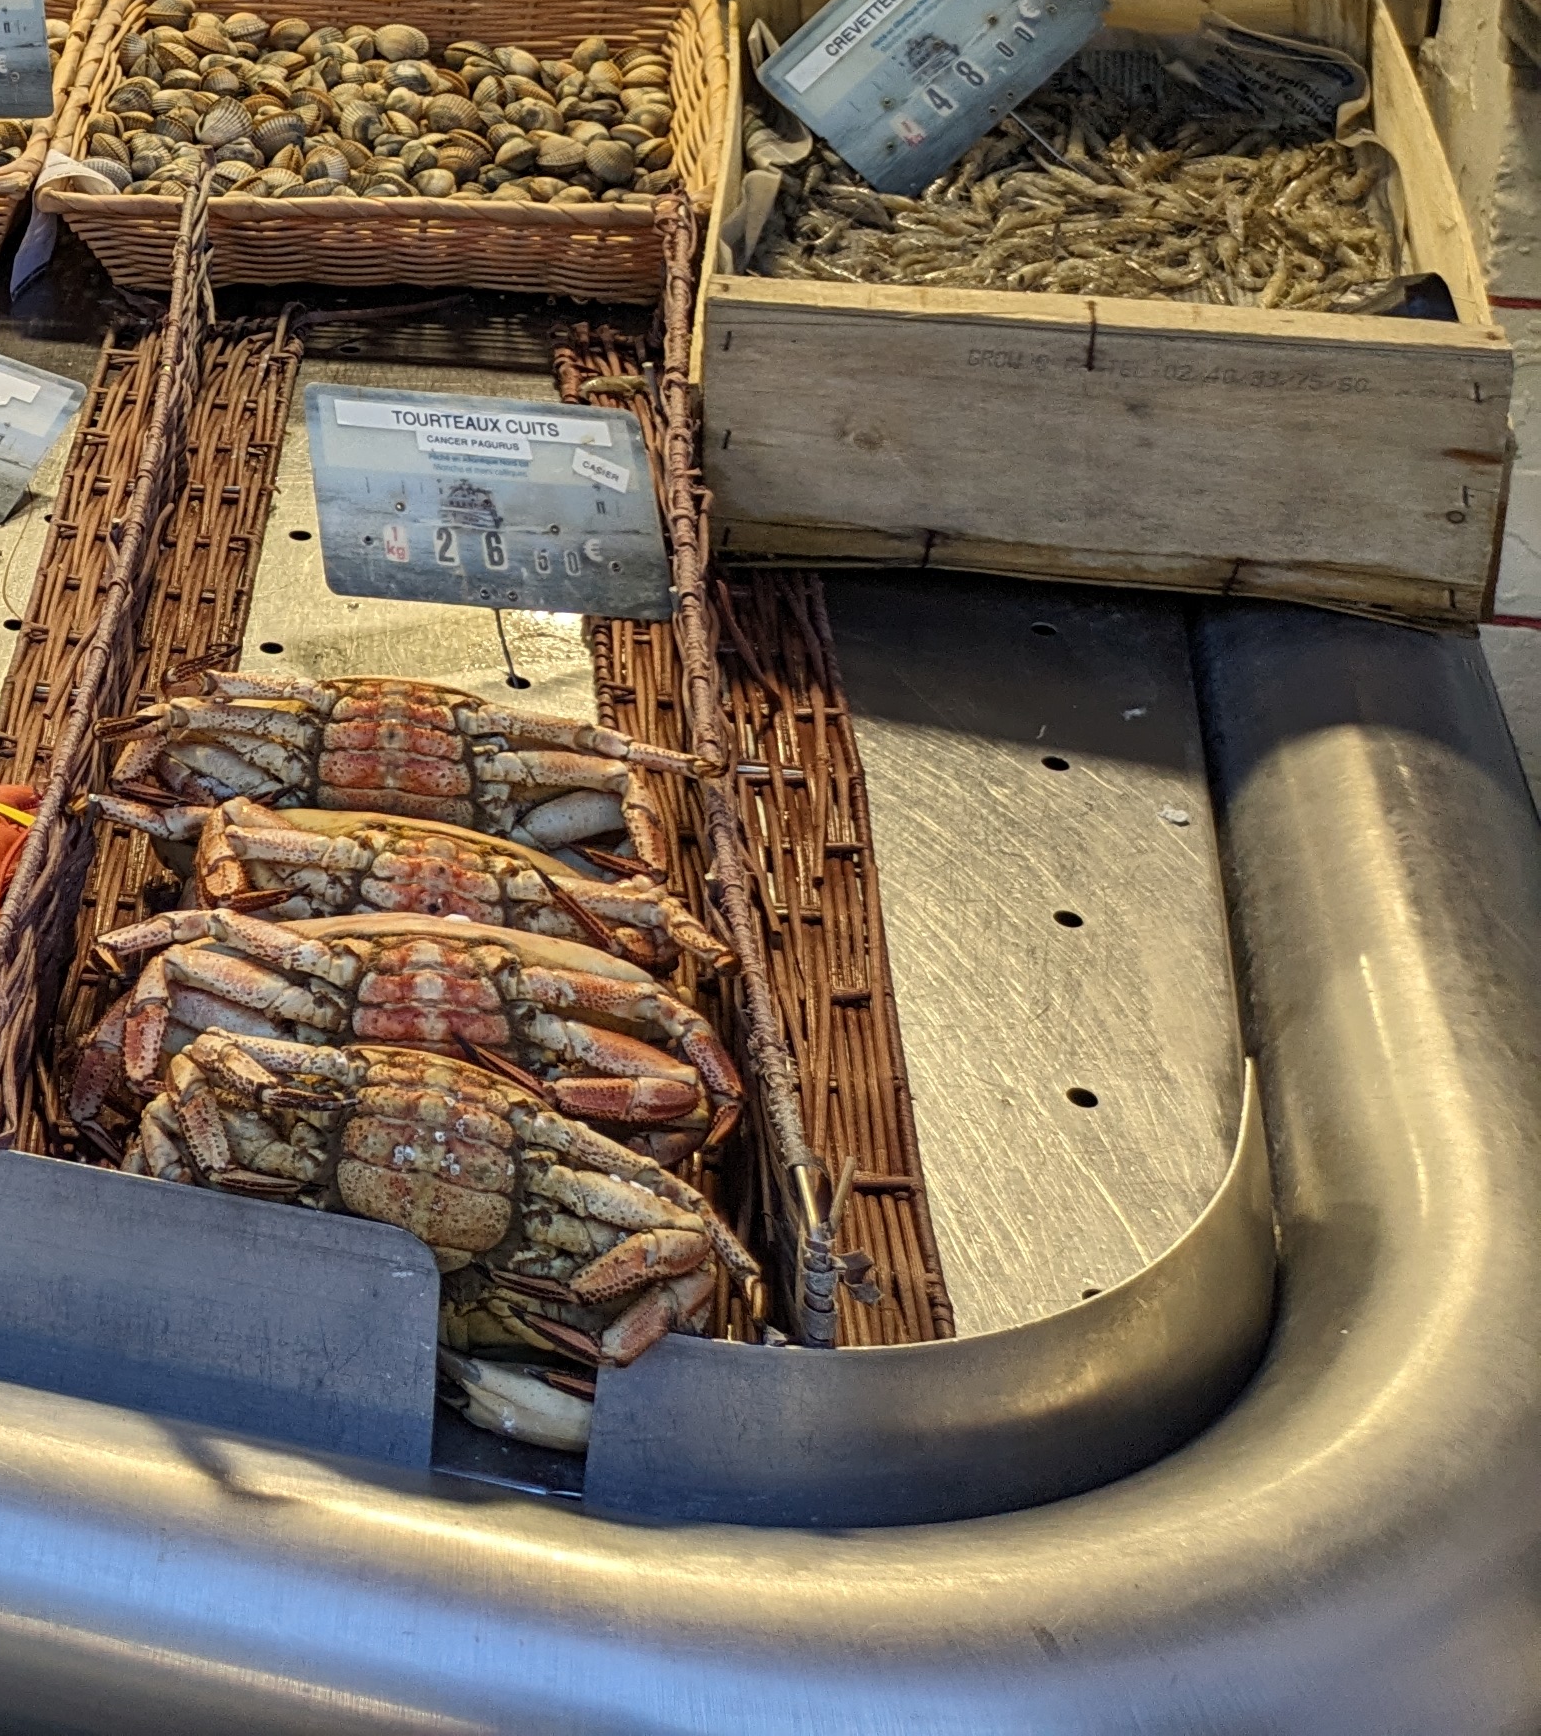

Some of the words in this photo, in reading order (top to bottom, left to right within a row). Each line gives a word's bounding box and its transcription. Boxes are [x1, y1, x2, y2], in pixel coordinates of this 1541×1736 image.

[390, 409, 503, 435] TOURTEAUX
[505, 420, 561, 438] CUITS
[426, 434, 468, 447] CANCER
[470, 437, 520, 452] PAGURUS
[581, 459, 620, 483] CASIER
[386, 541, 406, 561] kg
